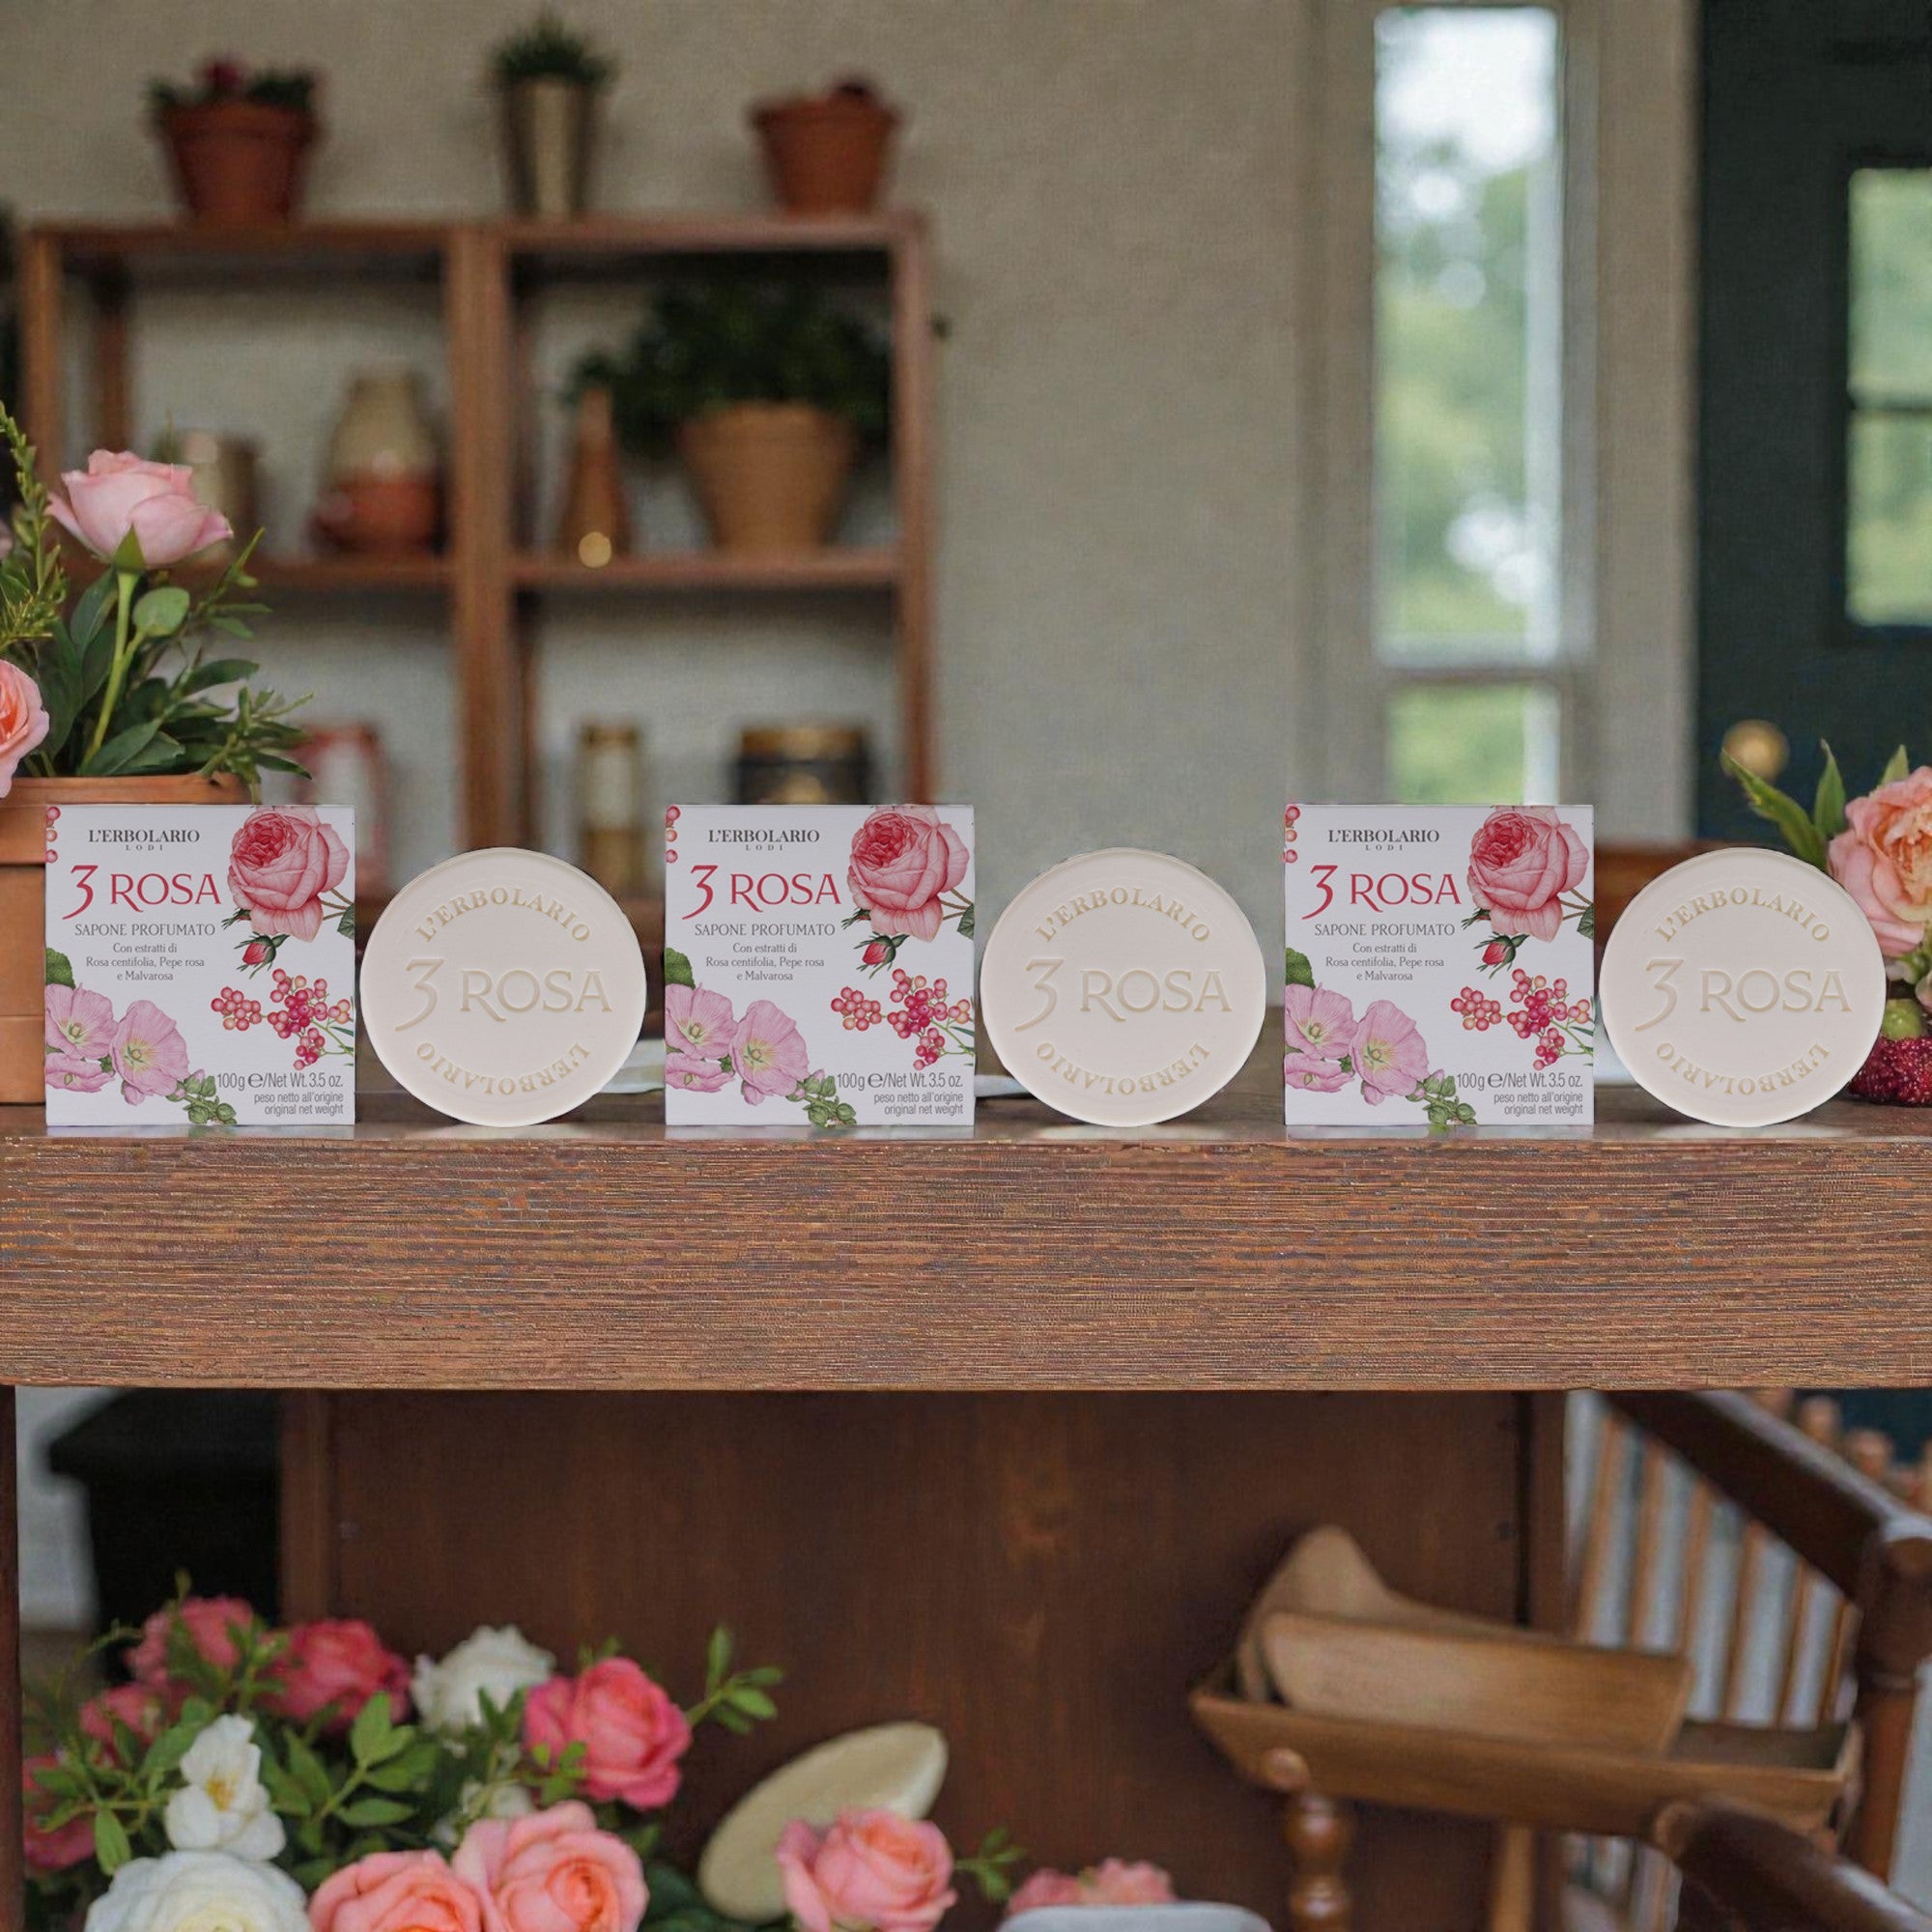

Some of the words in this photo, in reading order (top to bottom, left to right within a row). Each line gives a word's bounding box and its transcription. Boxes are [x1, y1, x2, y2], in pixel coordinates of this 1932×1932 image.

[89, 829, 200, 842] L'ERBOLARIO
[709, 829, 820, 842] L'ERBOLARIO
[1328, 829, 1439, 842] L'ERBOLARIO
[62, 865, 99, 920] 3
[110, 873, 221, 913] ROSA
[682, 865, 719, 920] 3
[730, 873, 841, 913] ROSA
[1301, 865, 1338, 920] 3
[1350, 873, 1461, 913] ROSA
[415, 887, 590, 943] L'ERBOLARIO
[1036, 887, 1210, 943] L'ERBOLARIO
[1655, 887, 1830, 943] L'ERBOLARIO
[74, 923, 128, 936] SAPONE
[131, 923, 215, 936] PROFUMATO
[695, 923, 748, 936] SAPONE
[752, 923, 836, 936] PROFUMATO
[1314, 923, 1367, 936] SAPONE
[1371, 923, 1455, 936] PROFUMATO
[113, 943, 132, 953] Con
[134, 943, 166, 953] estratti
[168, 943, 178, 953] di
[733, 943, 753, 953] Con
[754, 943, 786, 953] estratti
[788, 943, 798, 953] di
[1352, 943, 1372, 953] Con
[1374, 943, 1406, 953] estratti
[1407, 943, 1417, 953] di
[86, 956, 109, 967] Rosa
[111, 956, 157, 968] centifolia,
[159, 956, 183, 969] Pepe
[706, 956, 729, 967] Rosa
[731, 956, 778, 968] centifolia,
[780, 956, 803, 969] Pepe
[1325, 956, 1349, 967] Rosa
[1350, 956, 1397, 968] centifolia,
[1399, 956, 1422, 969] Pepe
[125, 971, 174, 980] Malvarosa
[745, 971, 794, 980] Malvarosa
[1364, 971, 1413, 980] Malvarosa
[394, 958, 445, 1032] 3
[460, 970, 612, 1022] ROSA
[1014, 958, 1065, 1032] 3
[1080, 970, 1233, 1022] ROSA
[1634, 958, 1685, 1032] 3
[1699, 970, 1852, 1022] ROSA
[415, 1041, 590, 1095] L'ERBOLARIO
[1036, 1041, 1210, 1095] L'ERBOLARIO
[1655, 1041, 1830, 1095] L'ERBOLARIO
[217, 1072, 245, 1092] 100g
[309, 1072, 326, 1088] 3.5
[328, 1075, 344, 1088] oz.
[838, 1072, 866, 1092] 100g
[929, 1072, 946, 1088] 3.5
[949, 1075, 964, 1088] oz.
[1457, 1072, 1485, 1092] 100g
[1548, 1072, 1565, 1088] 3.5
[1568, 1075, 1583, 1088] oz.
[254, 1094, 275, 1104] peso
[277, 1093, 299, 1102] netto
[301, 1092, 344, 1105] all'origine
[874, 1094, 895, 1104] peso
[897, 1093, 920, 1102] netto
[922, 1092, 964, 1105] all'origine
[1493, 1094, 1515, 1104] peso
[1517, 1093, 1539, 1102] netto
[1541, 1092, 1583, 1105] all'origine
[265, 1104, 297, 1117] original
[298, 1105, 312, 1115] net
[314, 1104, 344, 1117] weight
[885, 1104, 917, 1117] original
[919, 1105, 932, 1115] net
[934, 1104, 964, 1117] weight
[1504, 1104, 1536, 1117] original
[1538, 1105, 1551, 1115] net
[1553, 1104, 1583, 1117] weight
